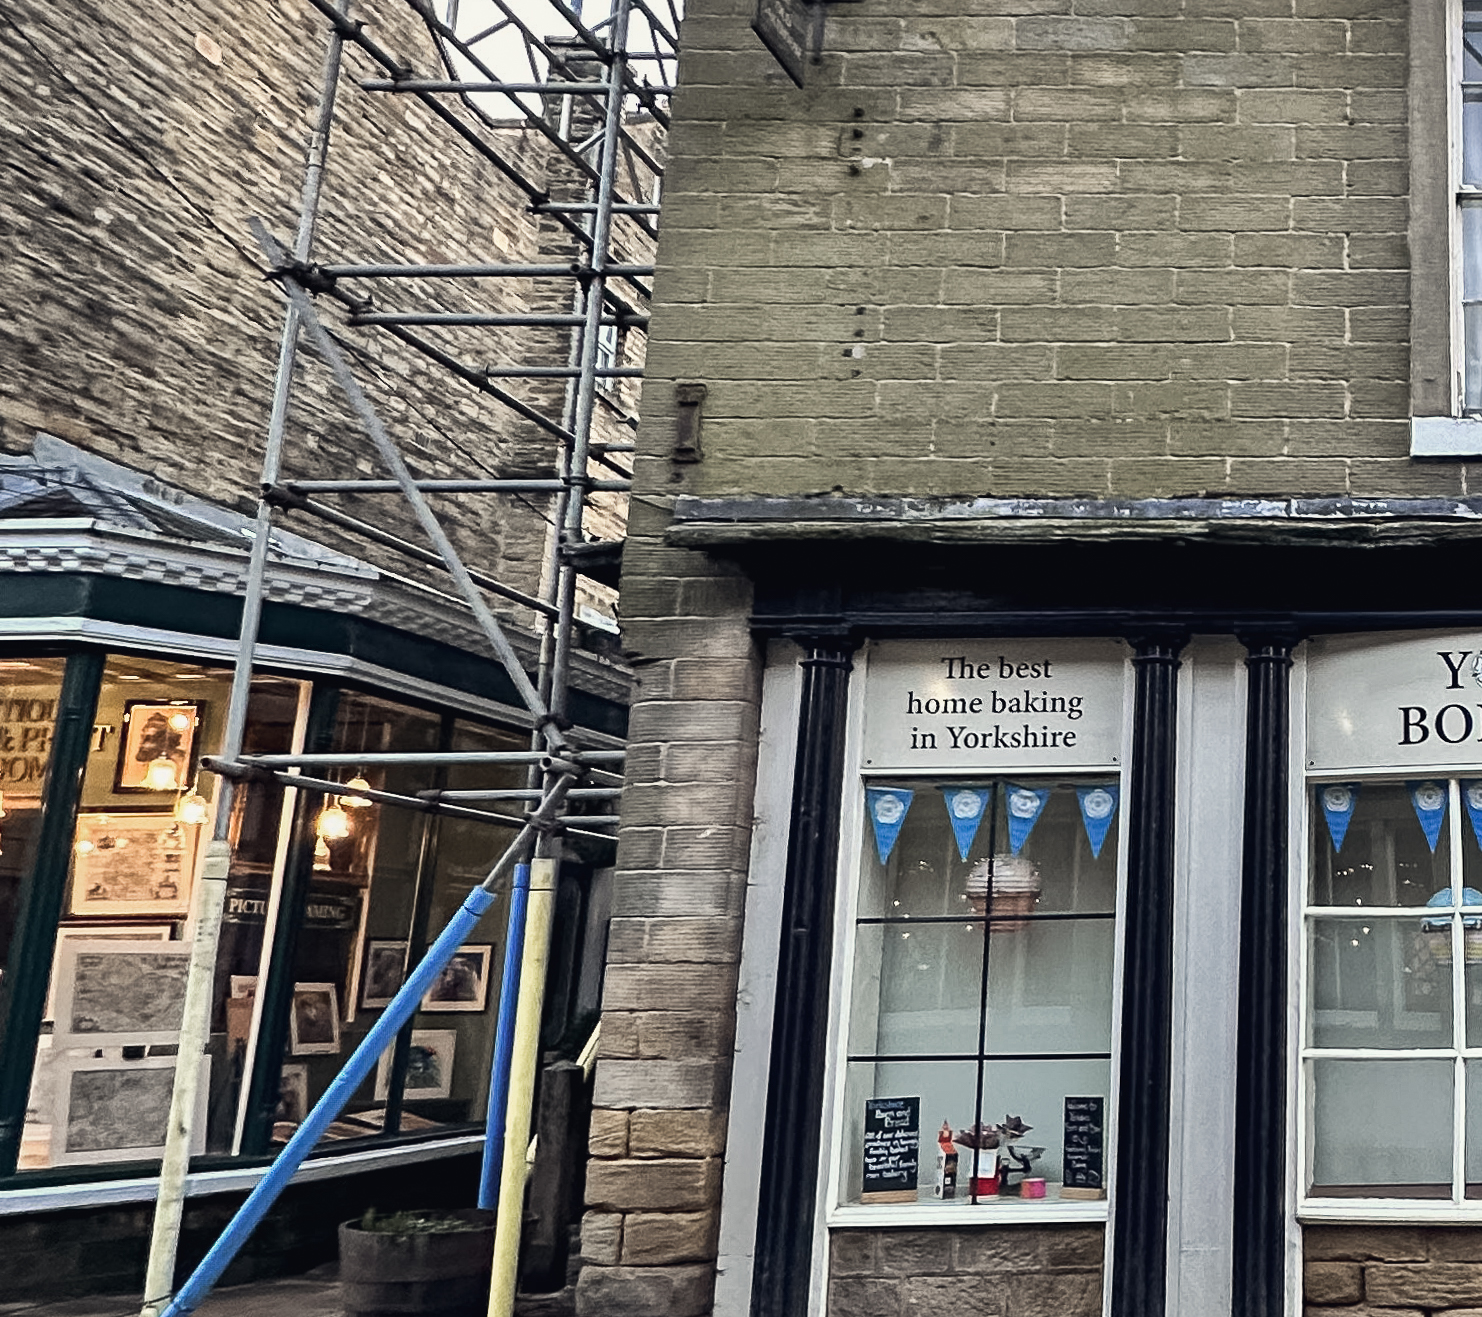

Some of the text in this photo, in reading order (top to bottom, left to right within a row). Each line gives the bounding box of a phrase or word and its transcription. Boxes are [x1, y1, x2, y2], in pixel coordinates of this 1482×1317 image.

[941, 656, 1052, 679] The best
[906, 690, 1083, 720] home baking
[910, 725, 1077, 749] in Yorkshire
